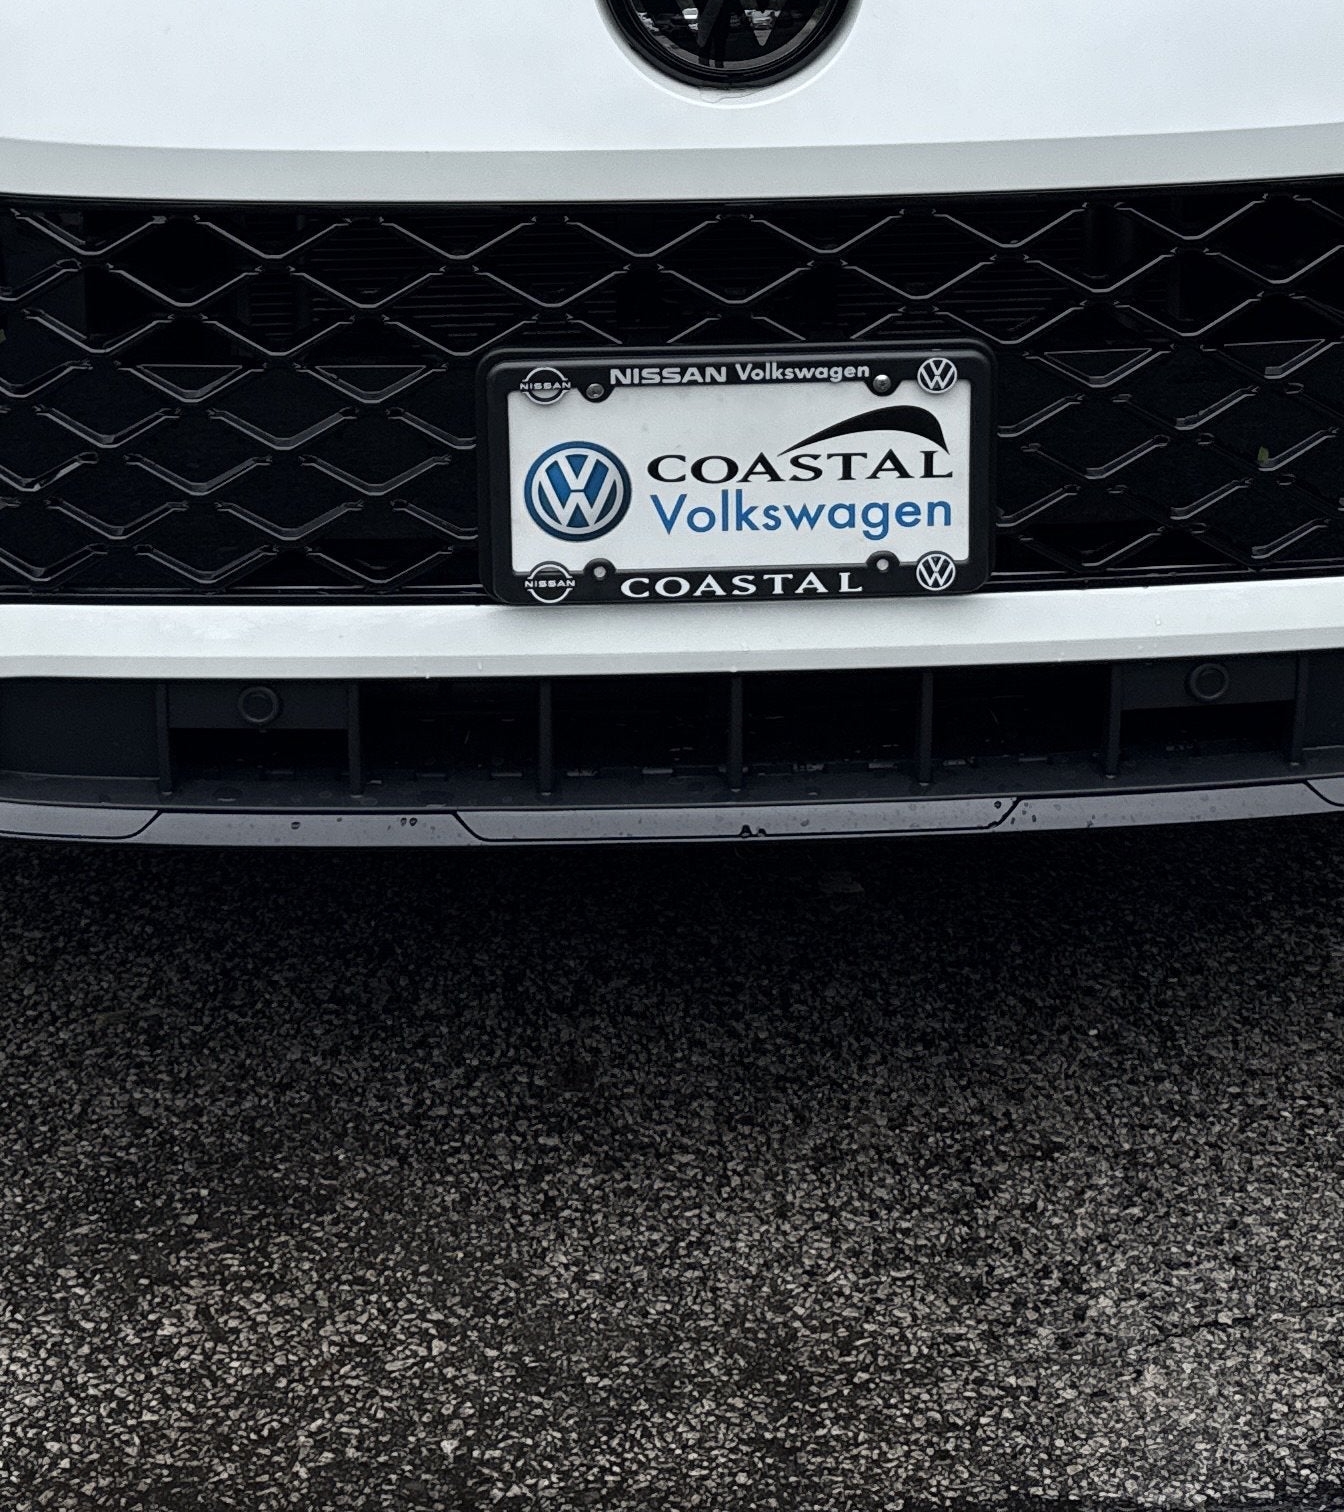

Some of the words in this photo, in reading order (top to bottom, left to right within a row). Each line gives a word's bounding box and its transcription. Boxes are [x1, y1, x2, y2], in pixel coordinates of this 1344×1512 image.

[520, 380, 572, 393] NISSAN
[610, 366, 727, 385] NISSAN
[734, 363, 871, 383] Volkswagen
[646, 450, 954, 485] COASTAL
[649, 489, 953, 542] Volkswagen
[524, 577, 576, 590] NISSAN
[621, 570, 865, 599] COASTAL
